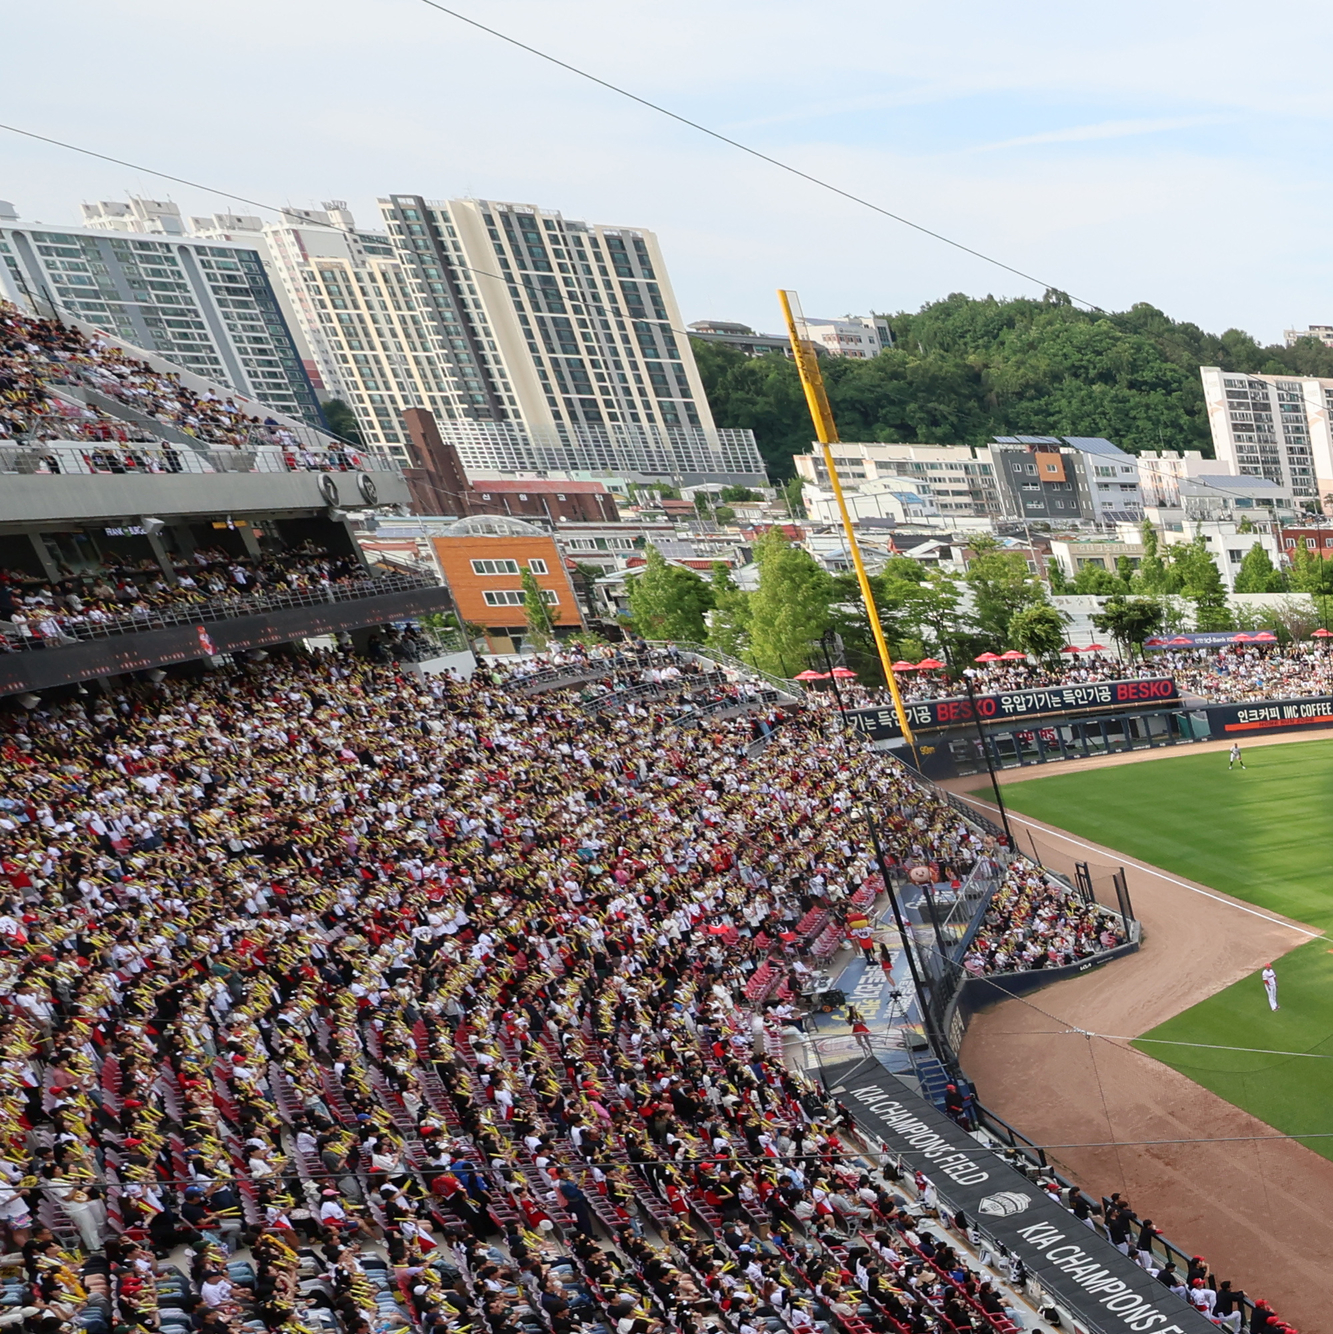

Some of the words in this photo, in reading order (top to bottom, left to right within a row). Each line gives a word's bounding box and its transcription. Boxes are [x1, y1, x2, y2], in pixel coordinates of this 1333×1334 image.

[936, 698, 998, 722] BESKO
[1000, 692, 1062, 714] 유압기기는
[1062, 685, 1112, 707] 득인기공
[1116, 678, 1174, 702] BESKO
[1237, 704, 1281, 724] 인크커피
[1300, 702, 1333, 718] COFFEE
[850, 1084, 879, 1106] KIA
[870, 1101, 957, 1162] CHAMPIONS
[933, 1151, 990, 1186] FIELD
[1017, 1221, 1063, 1251] KIA
